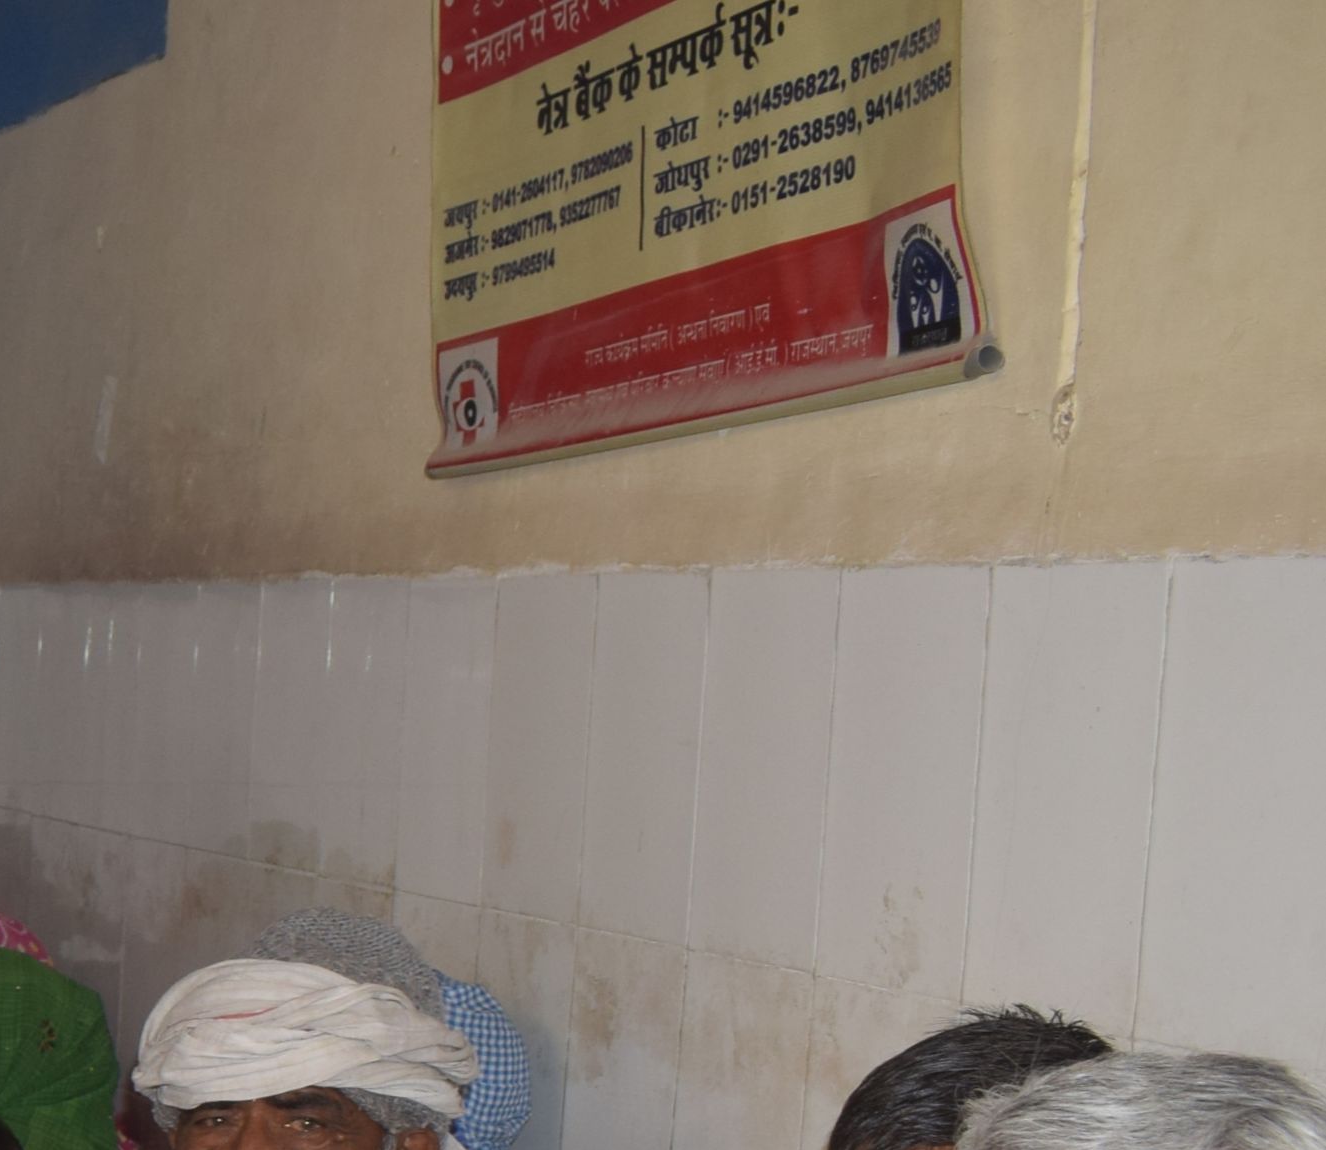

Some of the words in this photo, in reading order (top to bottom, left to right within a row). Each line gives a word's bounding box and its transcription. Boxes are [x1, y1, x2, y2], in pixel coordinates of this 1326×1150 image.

[464, 19, 526, 73] नेत्रदान
[536, 82, 572, 136] नेत्र
[573, 60, 615, 120] बैंक
[616, 43, 644, 102] के
[646, 2, 728, 91] सम्पर्क
[654, 116, 699, 150] कोटा
[733, 66, 847, 124] 9414596822,
[654, 156, 711, 194] जोधपुर
[732, 107, 862, 169] 0291-2638599,
[731, 155, 855, 216] 0151-2528190
